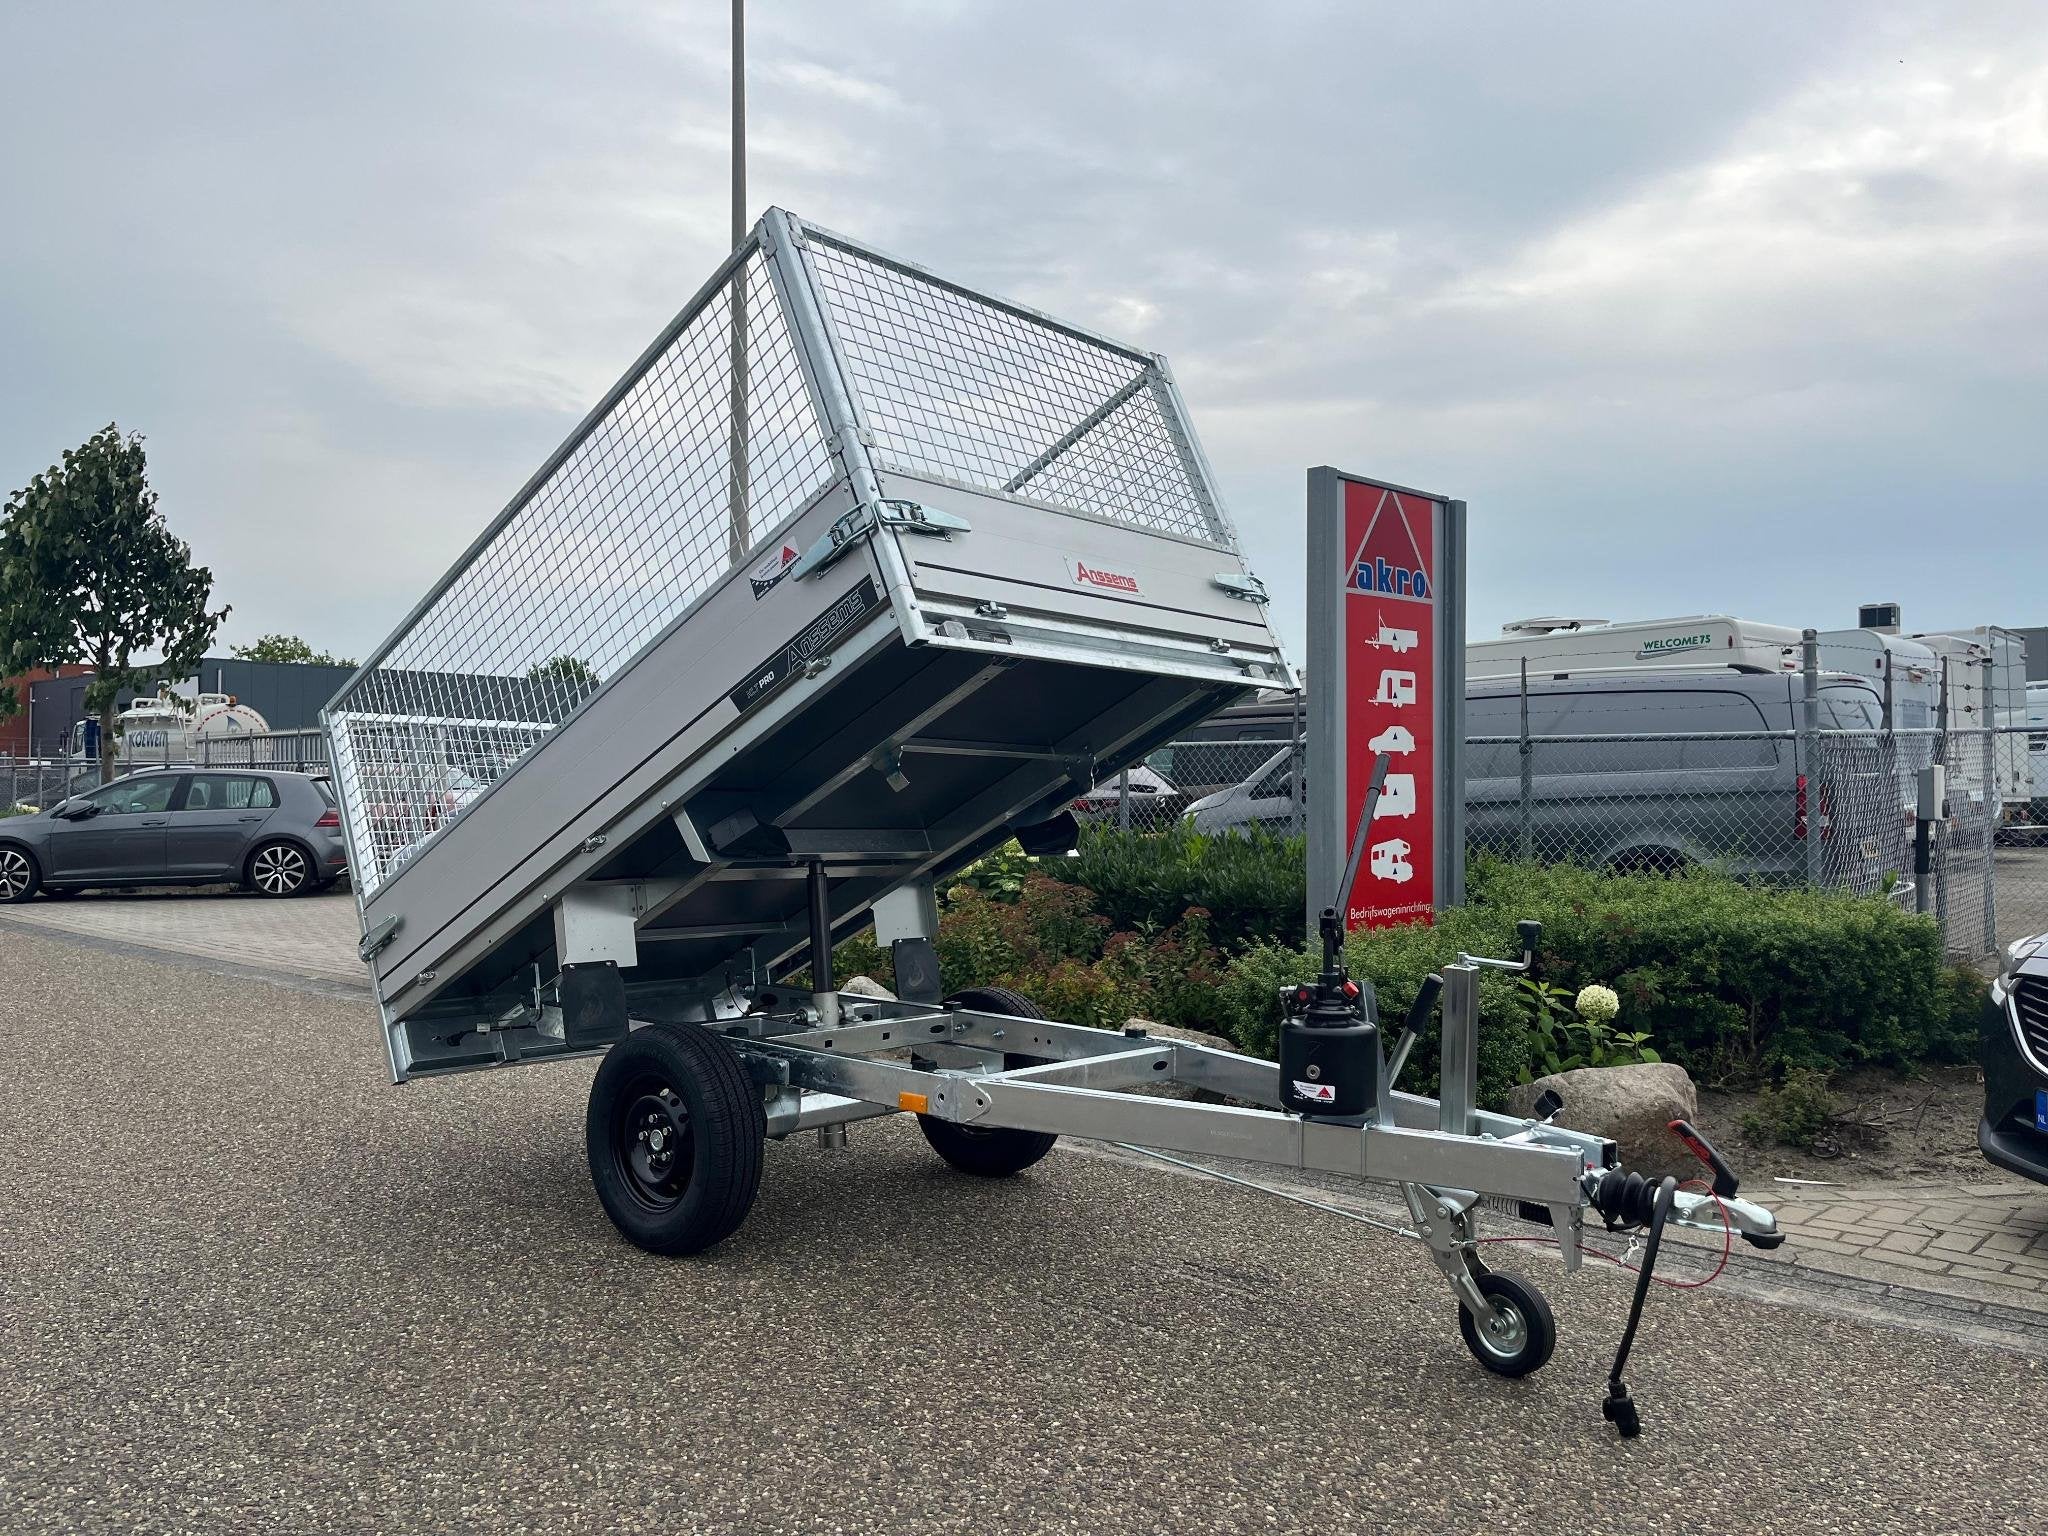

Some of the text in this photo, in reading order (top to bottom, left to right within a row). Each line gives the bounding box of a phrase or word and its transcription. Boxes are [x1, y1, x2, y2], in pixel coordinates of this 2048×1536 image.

[1077, 561, 1138, 593] Anssems
[1356, 556, 1427, 599] akro
[787, 590, 865, 676] Anssems
[1643, 634, 1711, 650] WELCOME 75
[758, 671, 775, 689] PRO
[2037, 1114, 2047, 1124] NL
